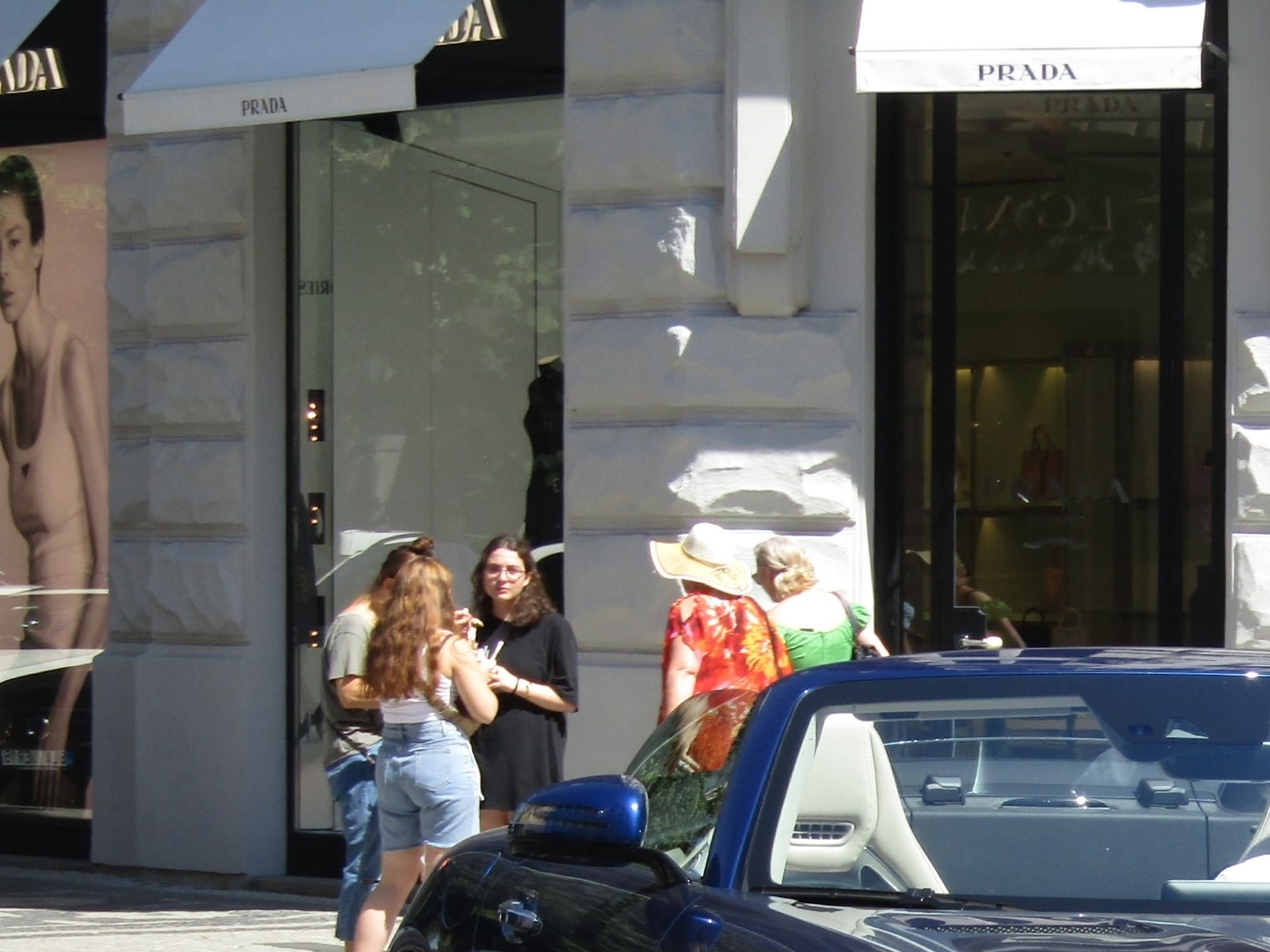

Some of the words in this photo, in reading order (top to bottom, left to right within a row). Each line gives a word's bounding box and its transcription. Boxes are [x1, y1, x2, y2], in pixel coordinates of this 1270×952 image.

[435, 0, 503, 46] DA
[976, 63, 1078, 81] PRADA
[241, 97, 288, 116] PRADA
